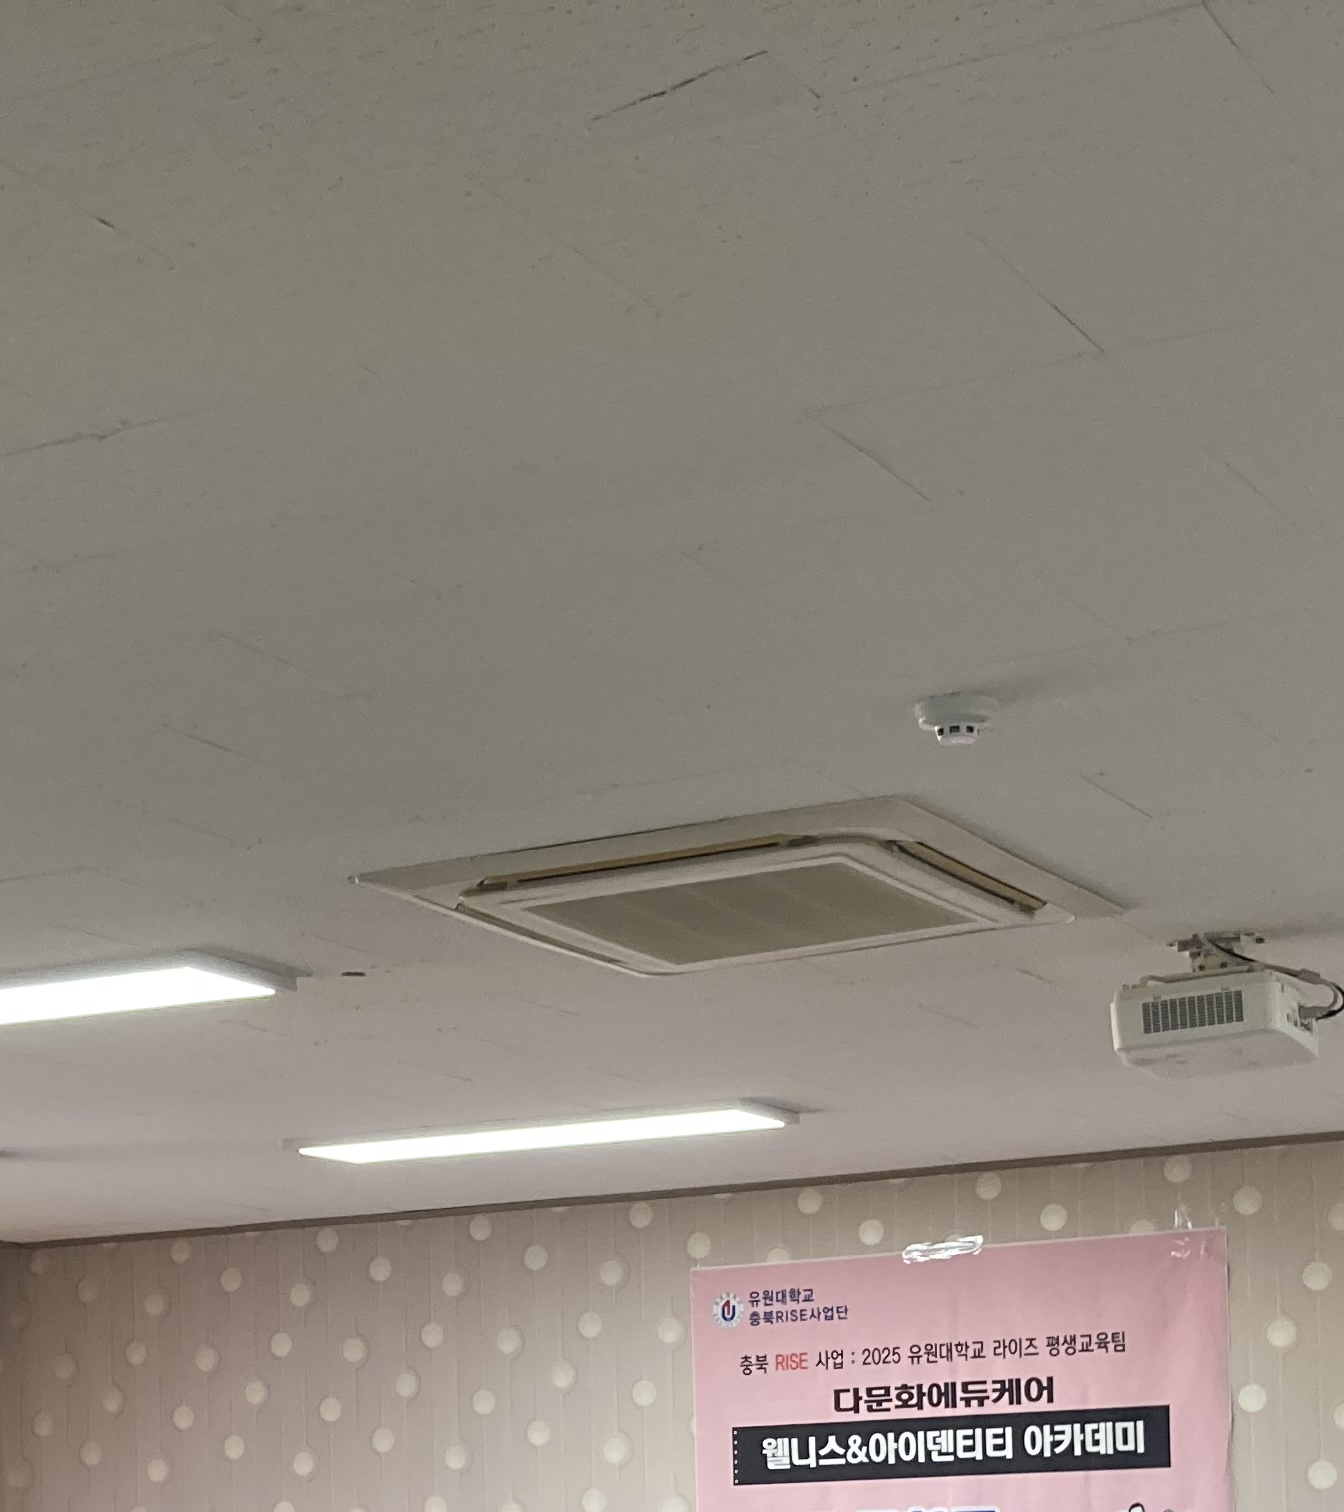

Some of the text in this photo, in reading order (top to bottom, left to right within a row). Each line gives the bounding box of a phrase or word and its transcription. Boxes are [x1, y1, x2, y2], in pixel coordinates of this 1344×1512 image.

[748, 1288, 814, 1307] 유원대학교
[749, 1305, 848, 1327] 충북RISE사업단
[740, 1354, 769, 1376] 충북
[775, 1352, 808, 1371] RISE
[816, 1350, 844, 1370] 사업
[862, 1346, 901, 1366] 2025
[908, 1341, 986, 1365] 유원대학교
[993, 1337, 1039, 1359] 라이즈
[1046, 1331, 1126, 1357] 평생교육팀
[833, 1376, 1054, 1414] 다문화에듀케어
[762, 1420, 1145, 1470] 웰니스&아이덴티티 아카데미
